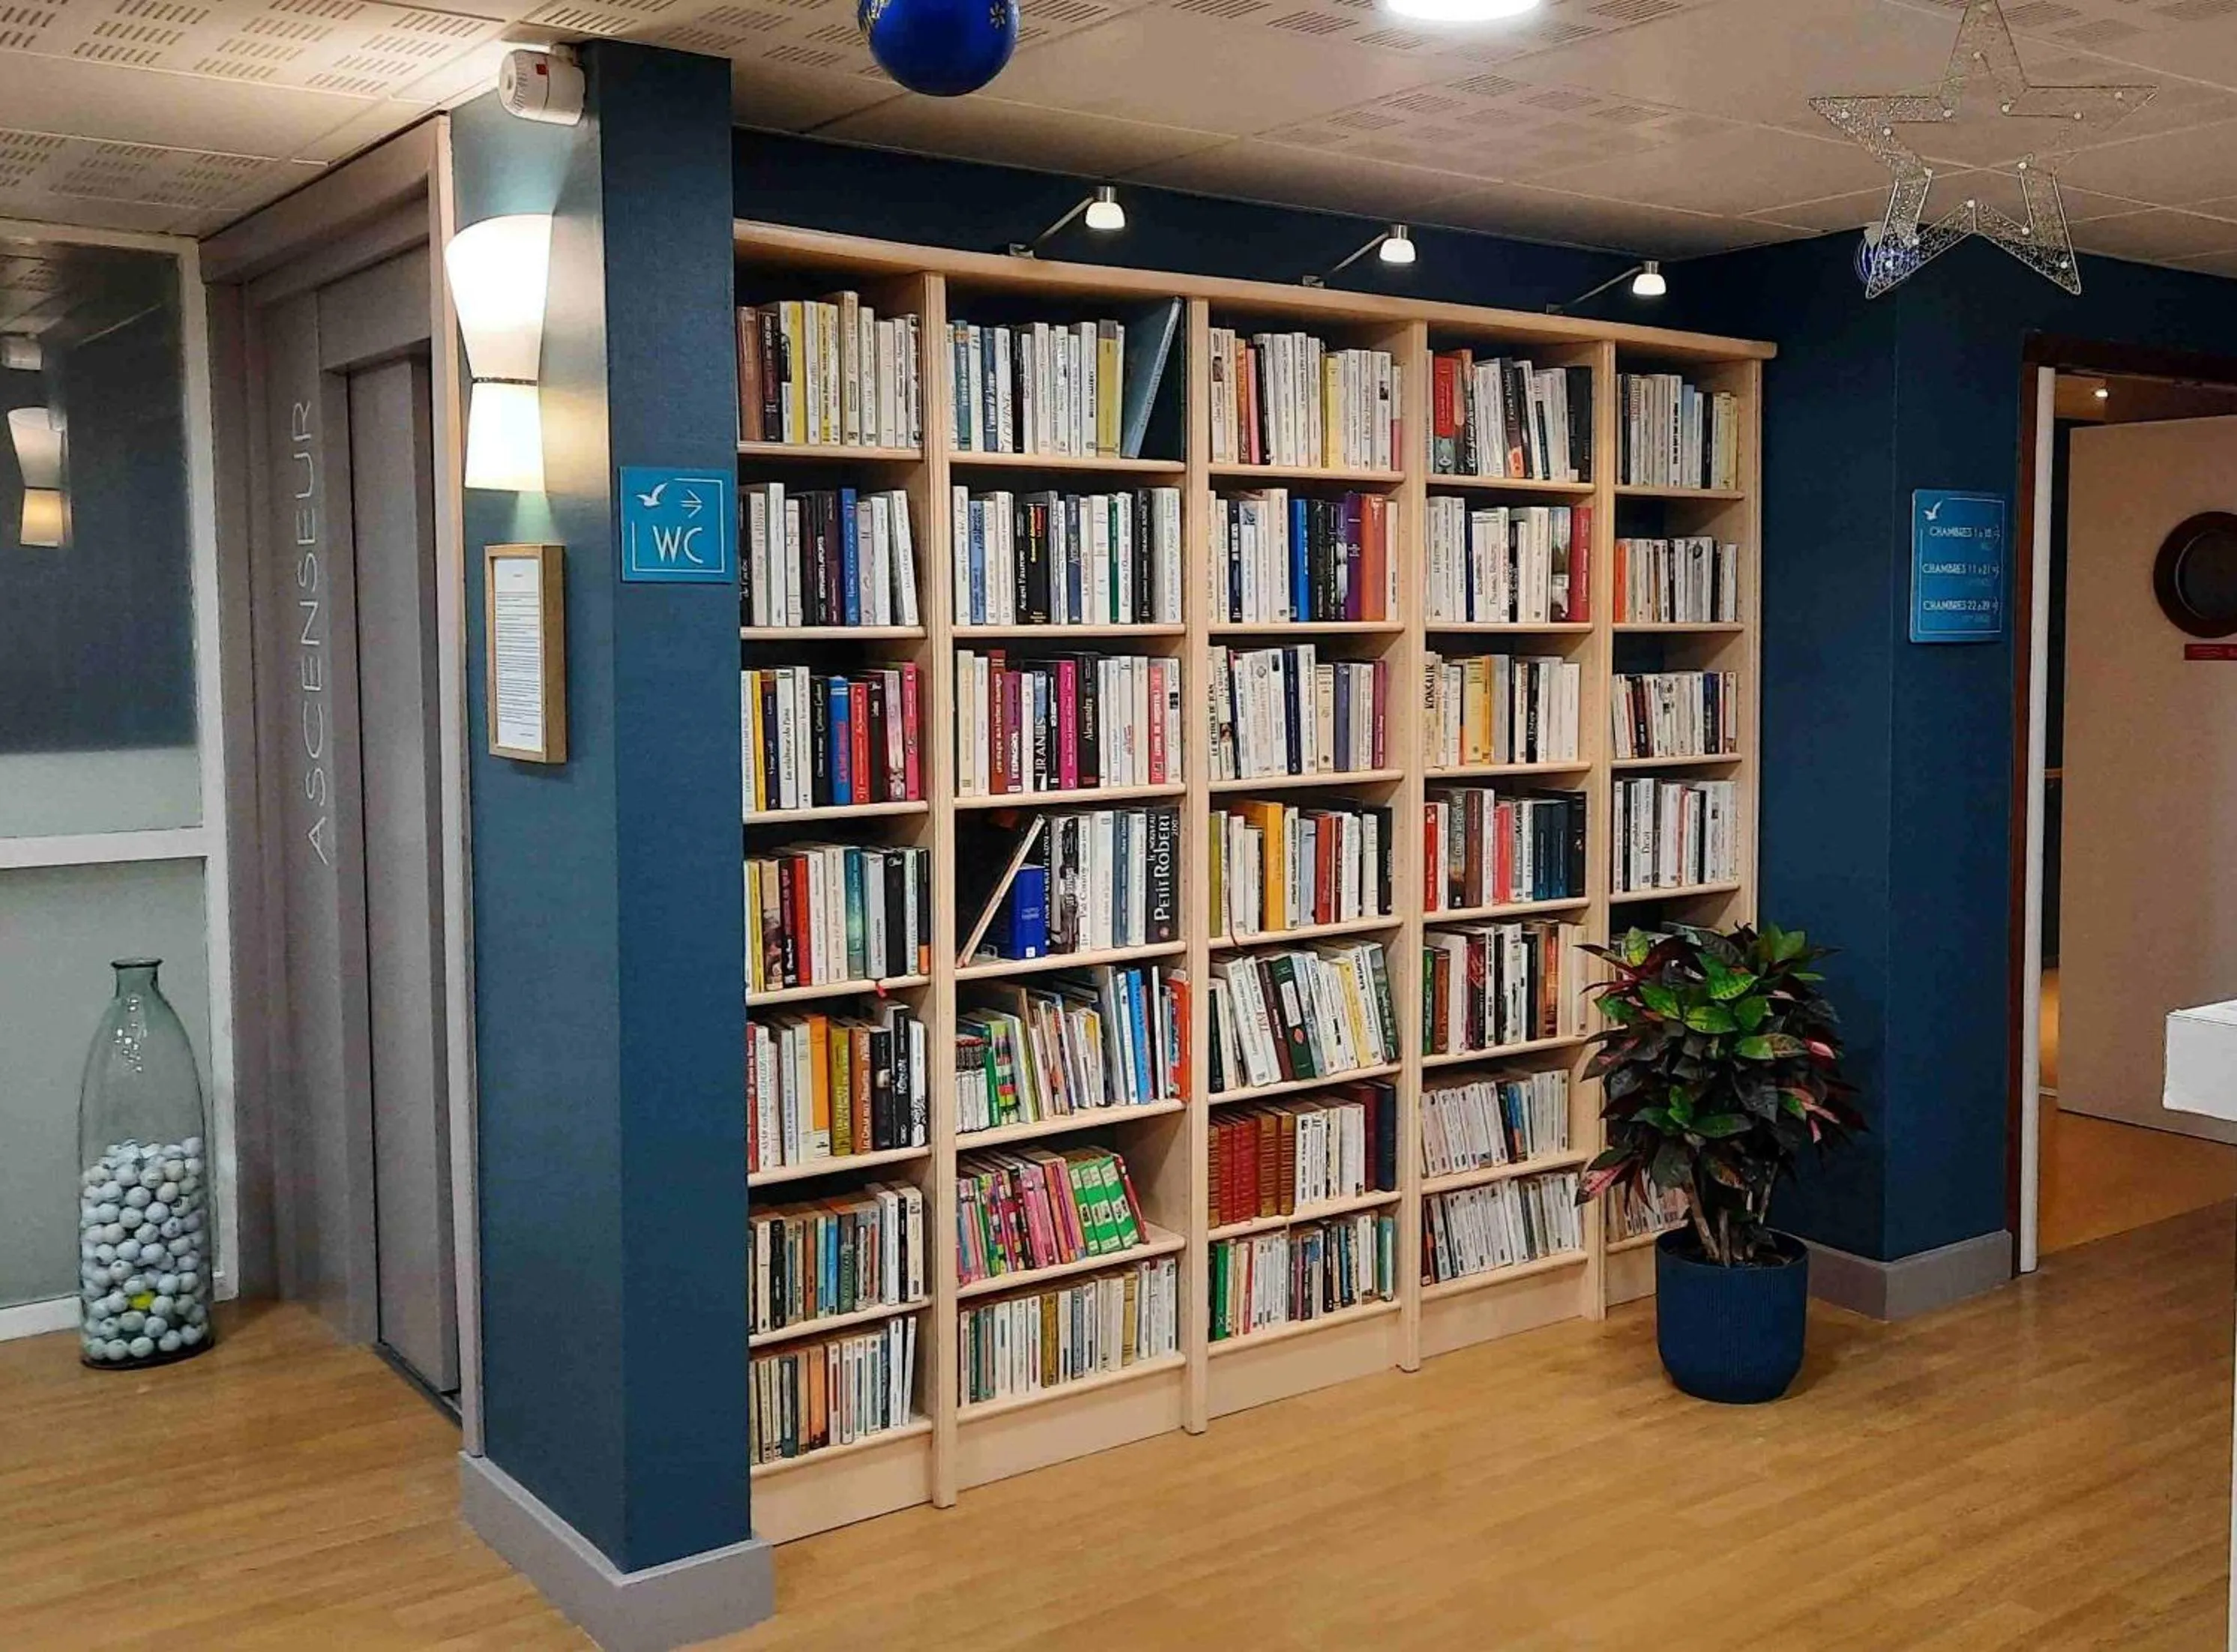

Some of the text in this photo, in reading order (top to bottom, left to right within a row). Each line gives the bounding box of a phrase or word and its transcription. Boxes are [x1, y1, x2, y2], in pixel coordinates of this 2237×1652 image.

[651, 526, 704, 564] WC
[1930, 526, 1972, 537] CHAMBRES
[1922, 563, 1966, 574] CHAMBRES
[1923, 600, 1966, 611] CHAMBRES
[292, 400, 328, 866] ASCENSEUR
[1425, 664, 1435, 709] KONSALIK
[1083, 698, 1094, 741] Alexandra
[1035, 717, 1047, 777] URANUS
[1153, 814, 1169, 921] PETIT ROBERT
